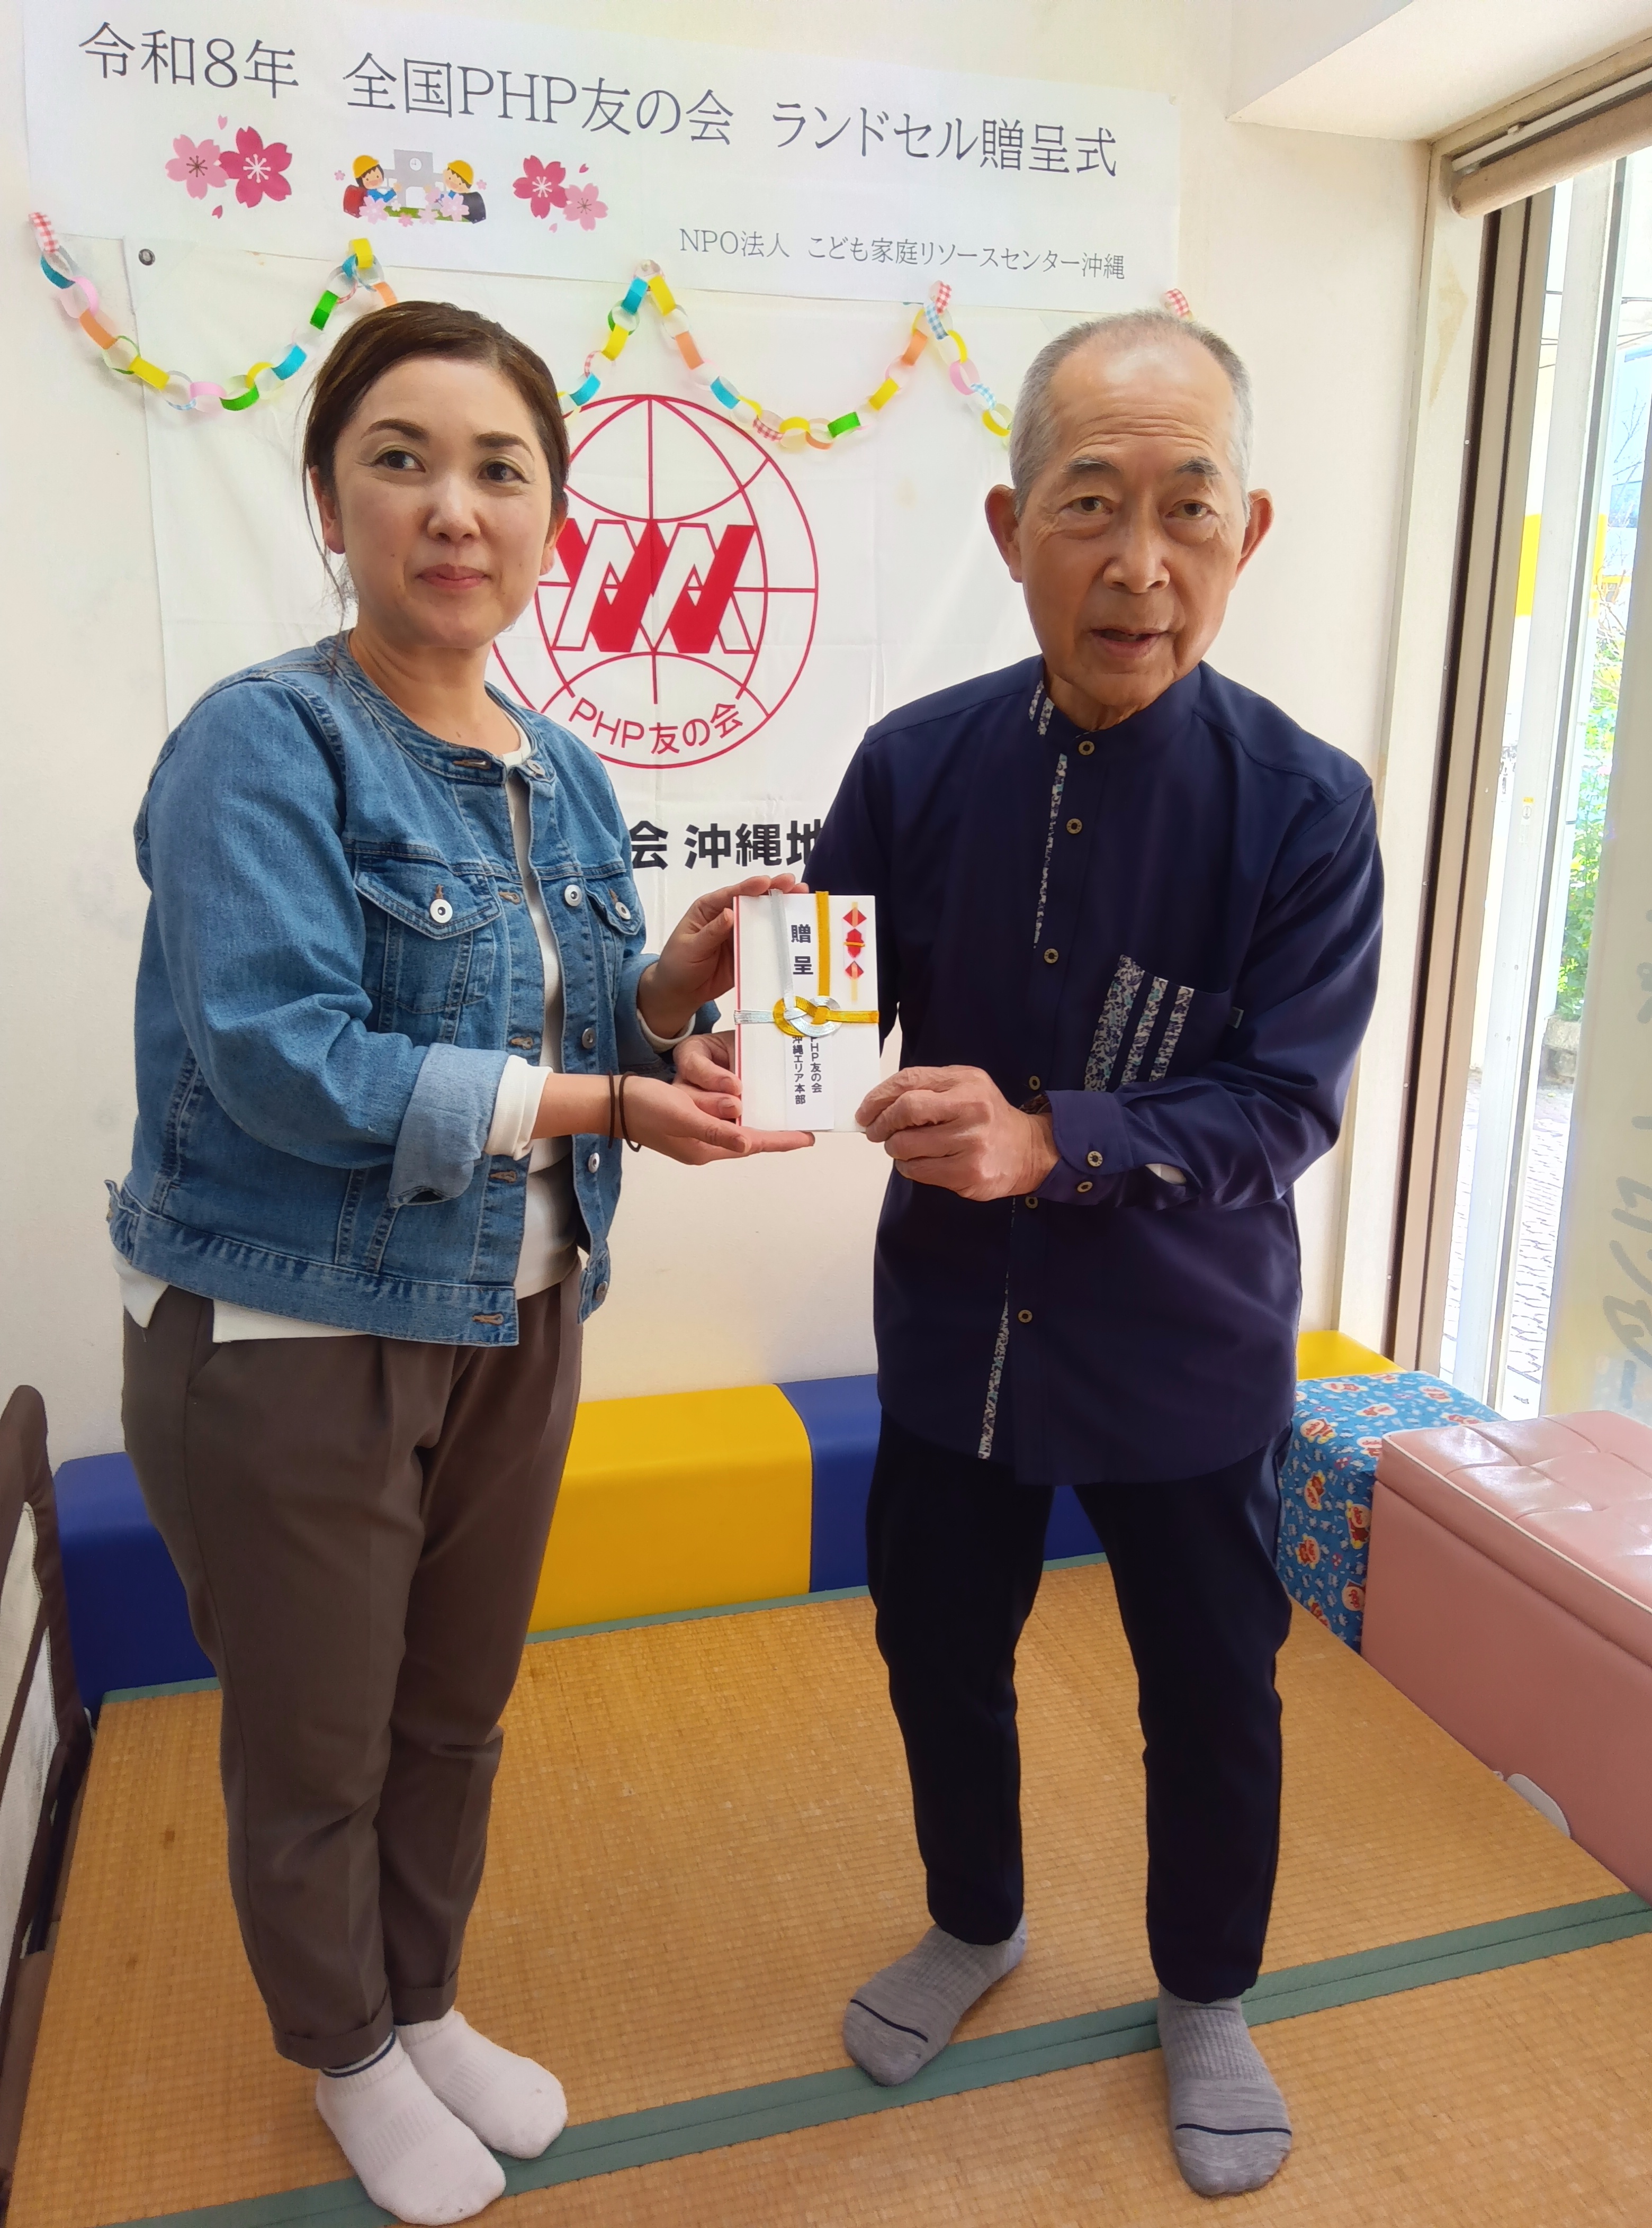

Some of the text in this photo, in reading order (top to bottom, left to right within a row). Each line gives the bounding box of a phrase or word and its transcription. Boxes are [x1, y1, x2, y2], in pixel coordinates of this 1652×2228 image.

[79, 22, 1117, 177] 令和8年 全国PHP友の会 ランドセル贈呈式
[679, 228, 1125, 280] NPO法人 こども家庭リソースセンター沖縄
[568, 697, 743, 755] PHP友の会
[791, 924, 814, 975] 贈呈
